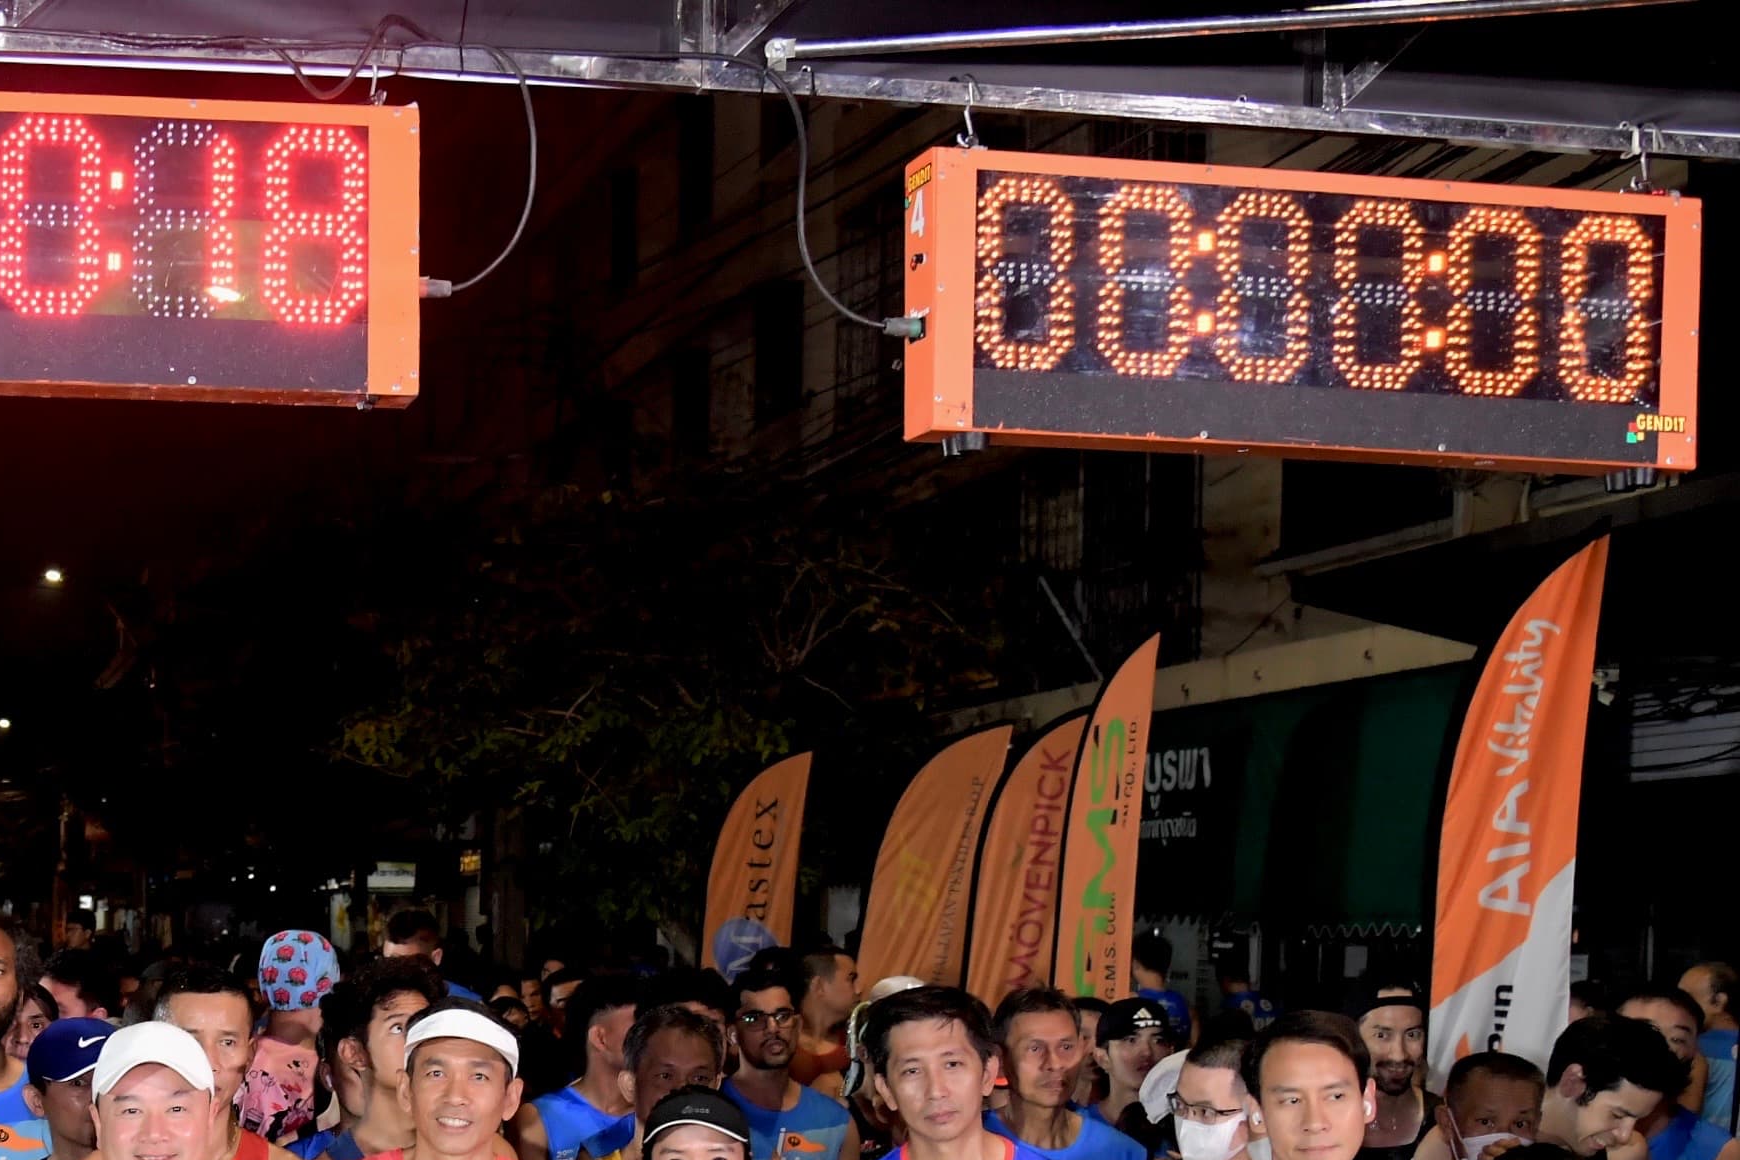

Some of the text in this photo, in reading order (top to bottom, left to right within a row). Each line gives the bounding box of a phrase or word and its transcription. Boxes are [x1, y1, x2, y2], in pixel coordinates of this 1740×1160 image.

[911, 188, 925, 238] 4
[975, 177, 1653, 403] 00:00:00
[1636, 413, 1686, 433] GENDIT
[1005, 746, 1072, 990] MÖVENPICK
[1478, 778, 1531, 917] AIA
